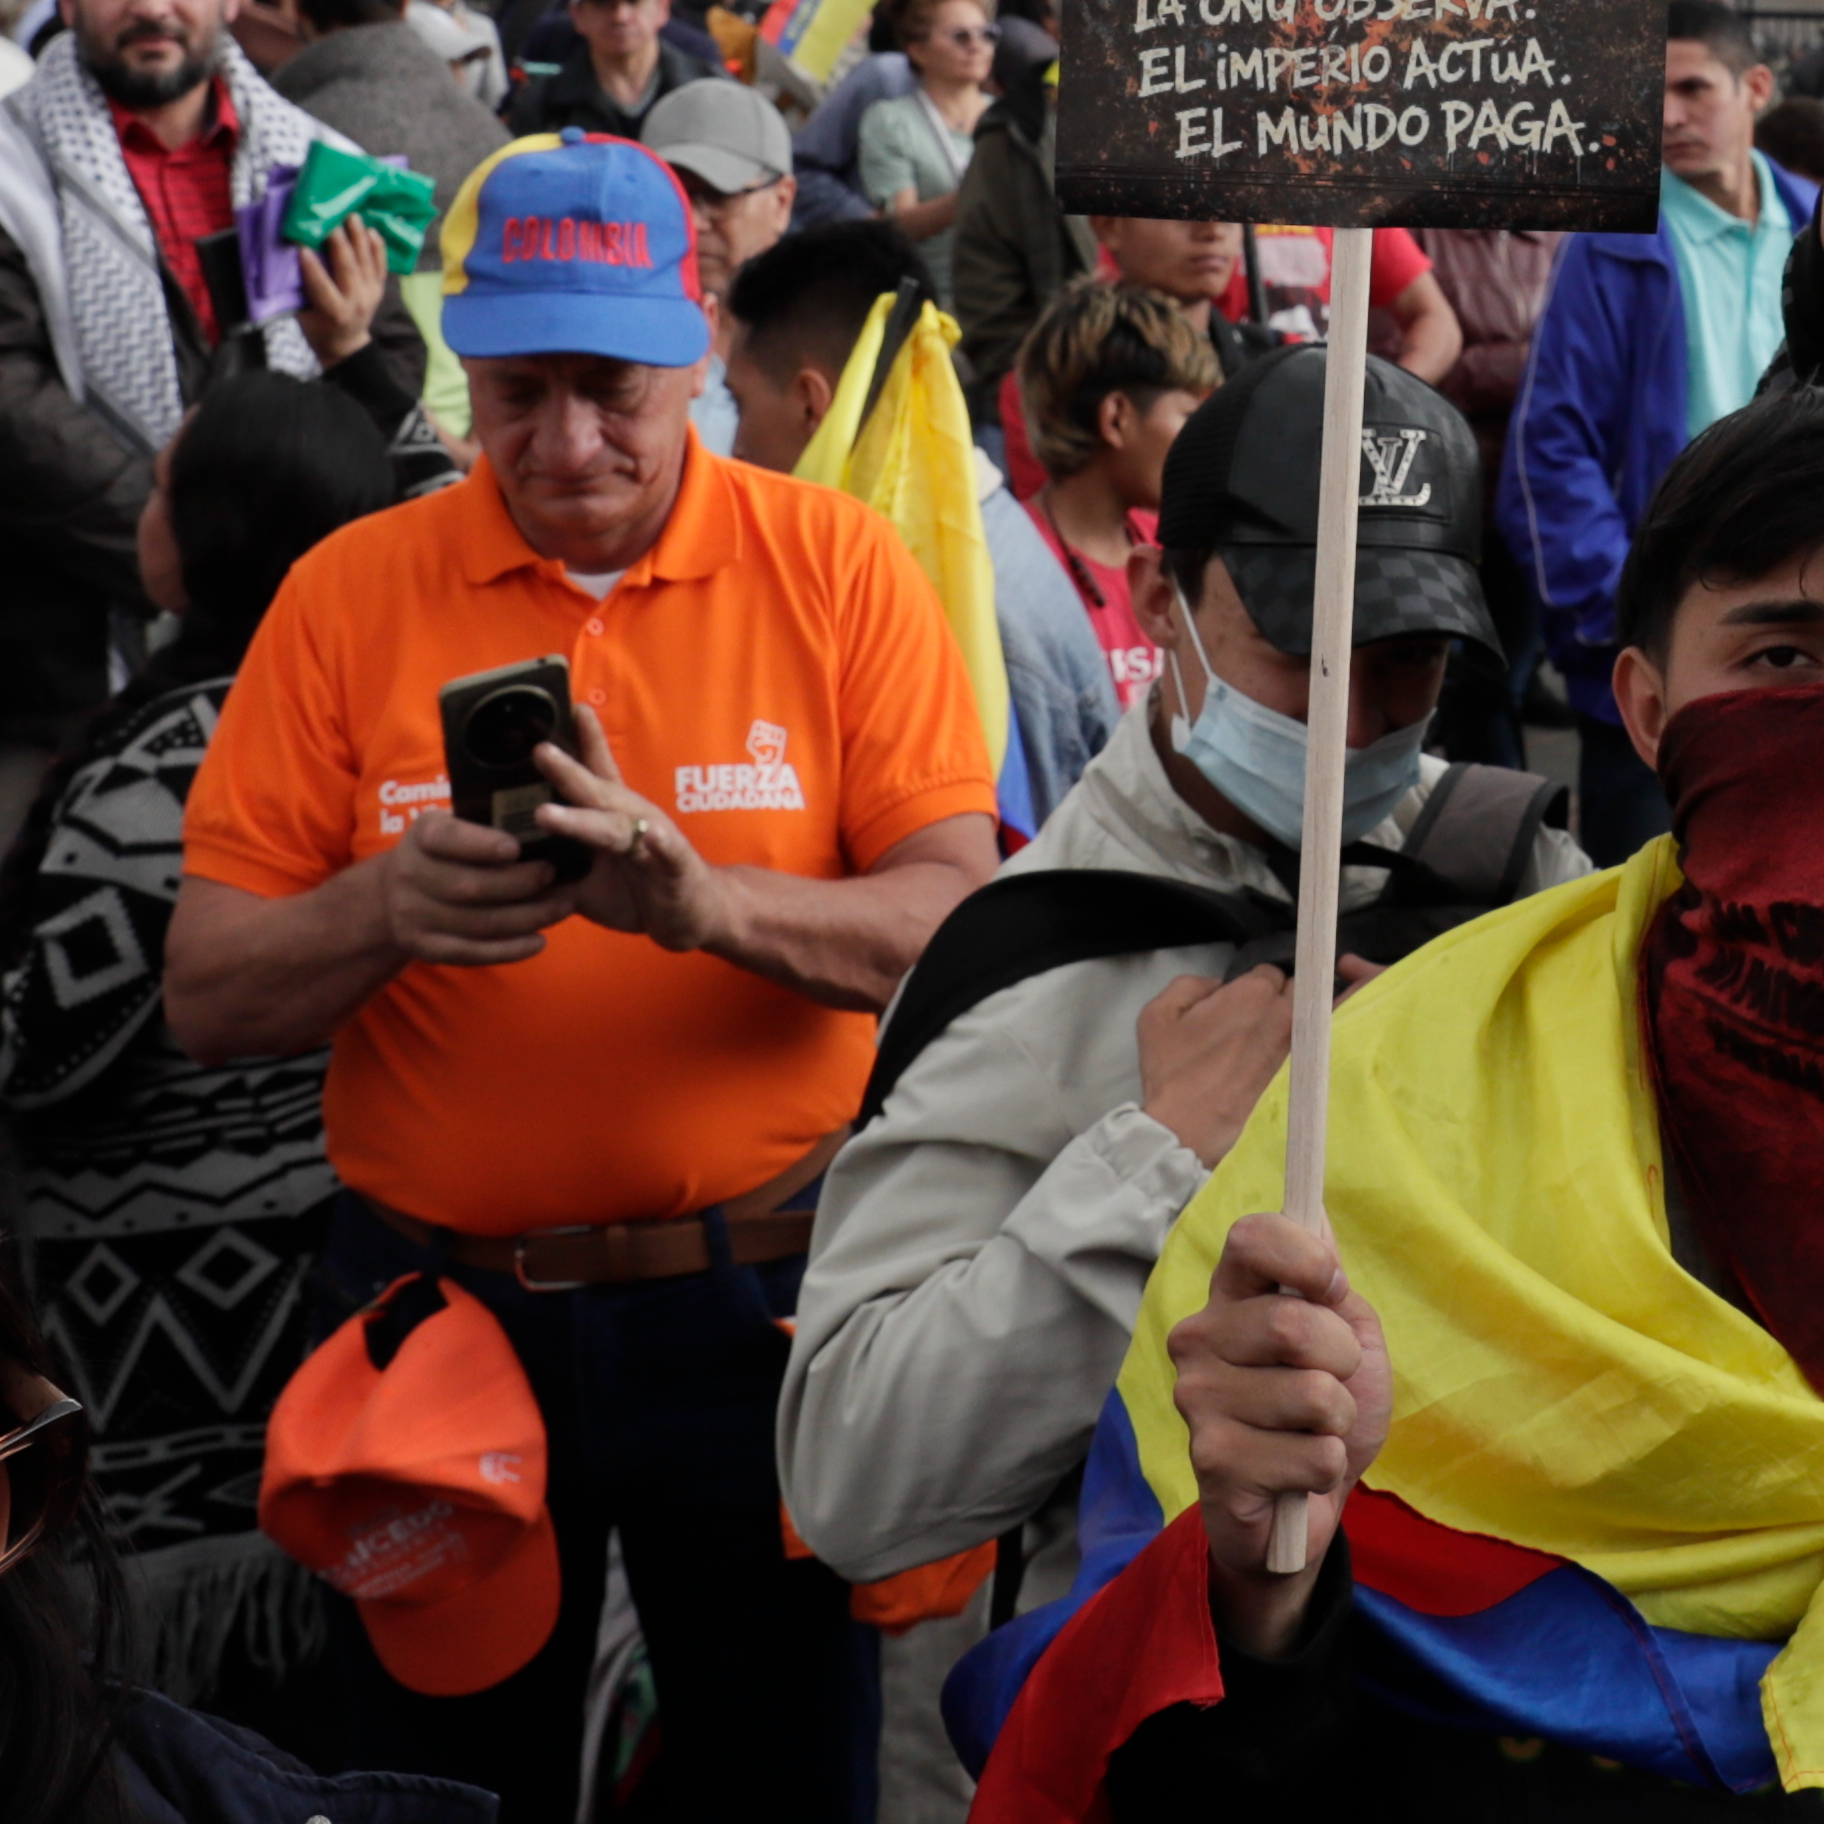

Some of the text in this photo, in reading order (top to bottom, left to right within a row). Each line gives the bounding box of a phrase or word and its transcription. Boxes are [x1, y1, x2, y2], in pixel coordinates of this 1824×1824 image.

[1137, 46, 1206, 98] EL
[1175, 99, 1600, 159] EL MUNDO PAGA.
[502, 216, 654, 268] COLOMBIA
[675, 763, 798, 791] FUERZA
[676, 789, 806, 813] CIUDADANA
